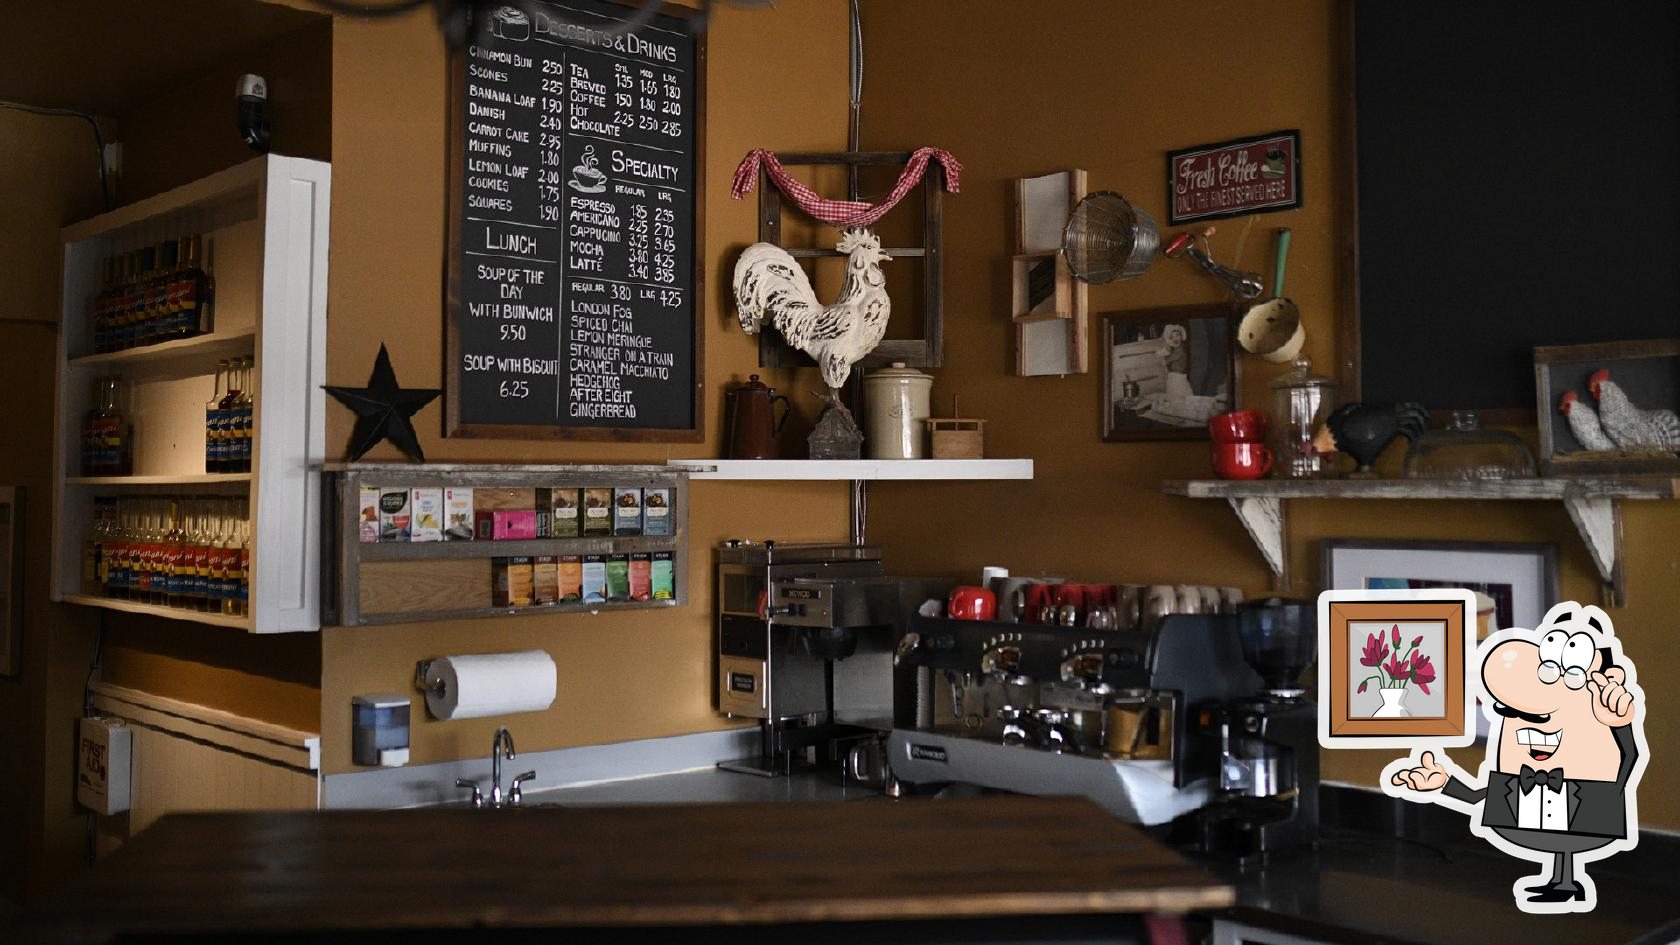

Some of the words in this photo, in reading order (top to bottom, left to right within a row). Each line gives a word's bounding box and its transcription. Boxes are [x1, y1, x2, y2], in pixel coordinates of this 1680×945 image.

[536, 12, 612, 48] DESSERTS
[628, 33, 676, 62] DRINKS
[514, 55, 532, 68] BUN
[470, 64, 508, 82] SCONES
[570, 64, 588, 79] TEA
[571, 77, 606, 94] BREWED
[470, 85, 511, 103] BANANA
[514, 94, 536, 107] LOAF
[571, 90, 606, 107] COFFEE
[470, 103, 505, 120] DANISH
[540, 115, 561, 130] 2.40
[571, 103, 588, 116] HOT
[469, 122, 502, 137] CARROT
[506, 128, 529, 143] CAKE
[570, 116, 620, 136] CHOCOLATE
[469, 139, 512, 157] MUFFINS
[540, 151, 559, 166] 1.80
[469, 158, 501, 174] LEMON
[506, 164, 528, 178] LOAF
[612, 150, 678, 182] SPECIALTY
[1177, 158, 1215, 194] Fresh
[1218, 151, 1257, 186] Coffee
[469, 177, 509, 192] COOKIES
[539, 185, 559, 201] 1.75
[615, 185, 645, 197] REGULAR
[468, 194, 512, 211] SQUARES
[539, 205, 558, 221] 1.90
[571, 197, 615, 214] ESPRESSO
[570, 211, 619, 227] AMERICANO
[487, 227, 536, 255] LUNCH
[570, 225, 621, 242] CAPPUCINO
[570, 241, 604, 256] MOCHA
[478, 265, 505, 280] SOUP
[508, 269, 520, 282] OF
[523, 270, 544, 284] THE
[501, 284, 523, 299] DAY
[572, 282, 605, 293] REGULAR
[641, 290, 655, 301] LRG
[469, 302, 499, 318] WITH
[503, 306, 552, 322] BUNWICH
[571, 300, 610, 315] LONDON
[613, 305, 632, 319] FOG
[571, 316, 607, 331] SPICED
[612, 319, 632, 333] CHAI
[571, 329, 604, 344] LEMON
[608, 333, 653, 348] MERINGUE
[570, 343, 620, 360] STRANGER
[625, 350, 636, 362] ON
[639, 352, 646, 363] A
[647, 351, 673, 366] TRAIN
[464, 354, 494, 371] SOUP
[497, 358, 520, 372] WITH
[523, 358, 558, 375] BISCUIT
[570, 358, 617, 375] CARAMEL
[621, 362, 668, 380] MACCHIATO
[500, 381, 529, 398] 6.25
[570, 374, 620, 389] HEDGEHOG
[570, 388, 602, 402] AFTER
[605, 389, 632, 402] EIGHT
[570, 402, 636, 419] GINGERBREAD
